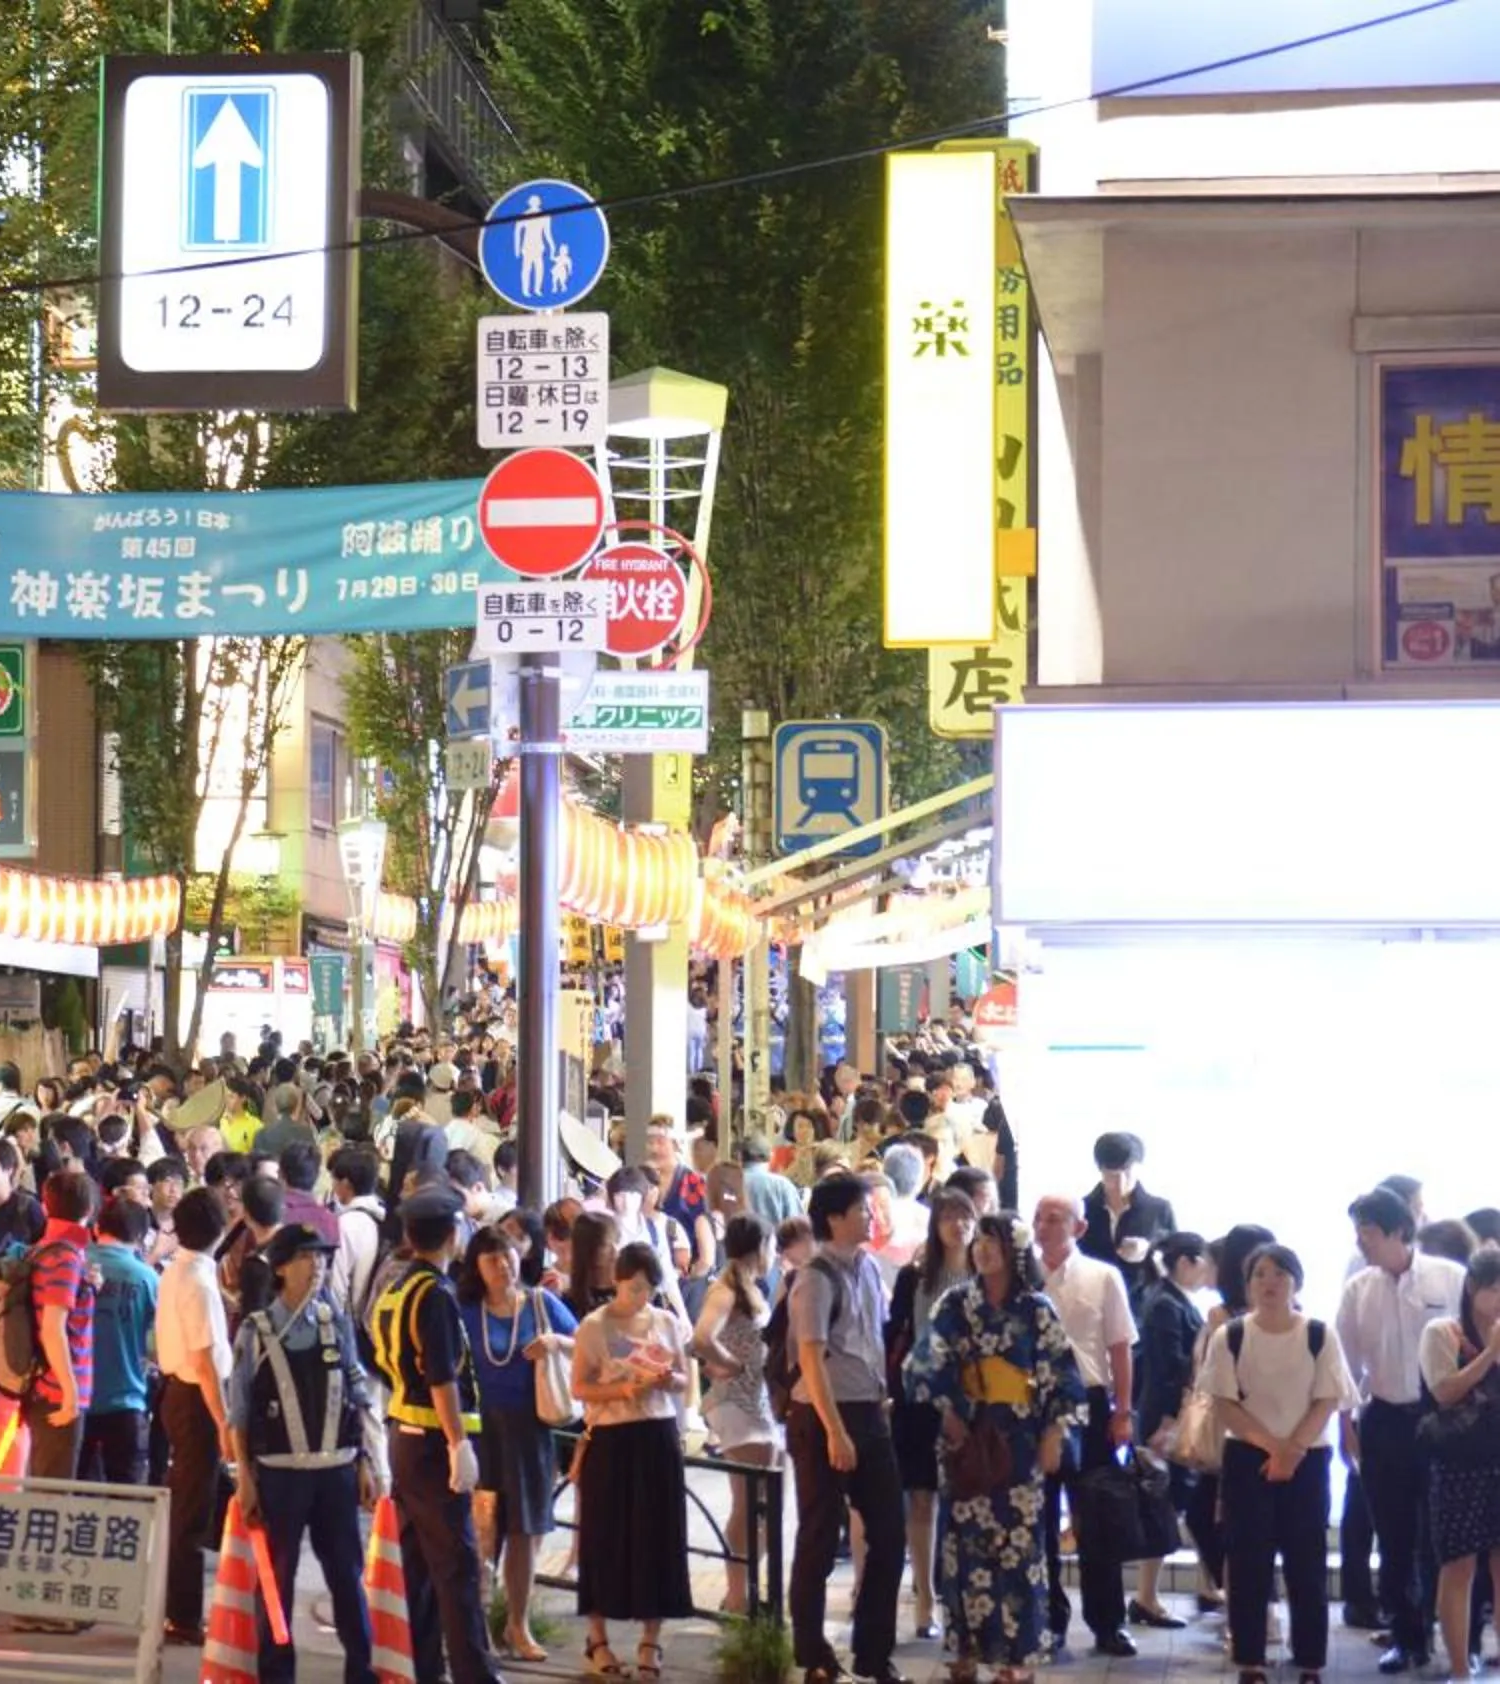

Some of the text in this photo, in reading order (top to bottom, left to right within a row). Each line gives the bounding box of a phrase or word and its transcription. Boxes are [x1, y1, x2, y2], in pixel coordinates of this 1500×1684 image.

[158, 293, 293, 328] 12-24
[486, 327, 600, 352] 自転車を除く
[121, 536, 197, 559] 第45回
[341, 515, 474, 557] 阿波踊り
[595, 559, 669, 572] FIRE HYDRANT
[10, 567, 308, 620] 神楽坂まつり
[484, 591, 598, 615] 自転車を除く
